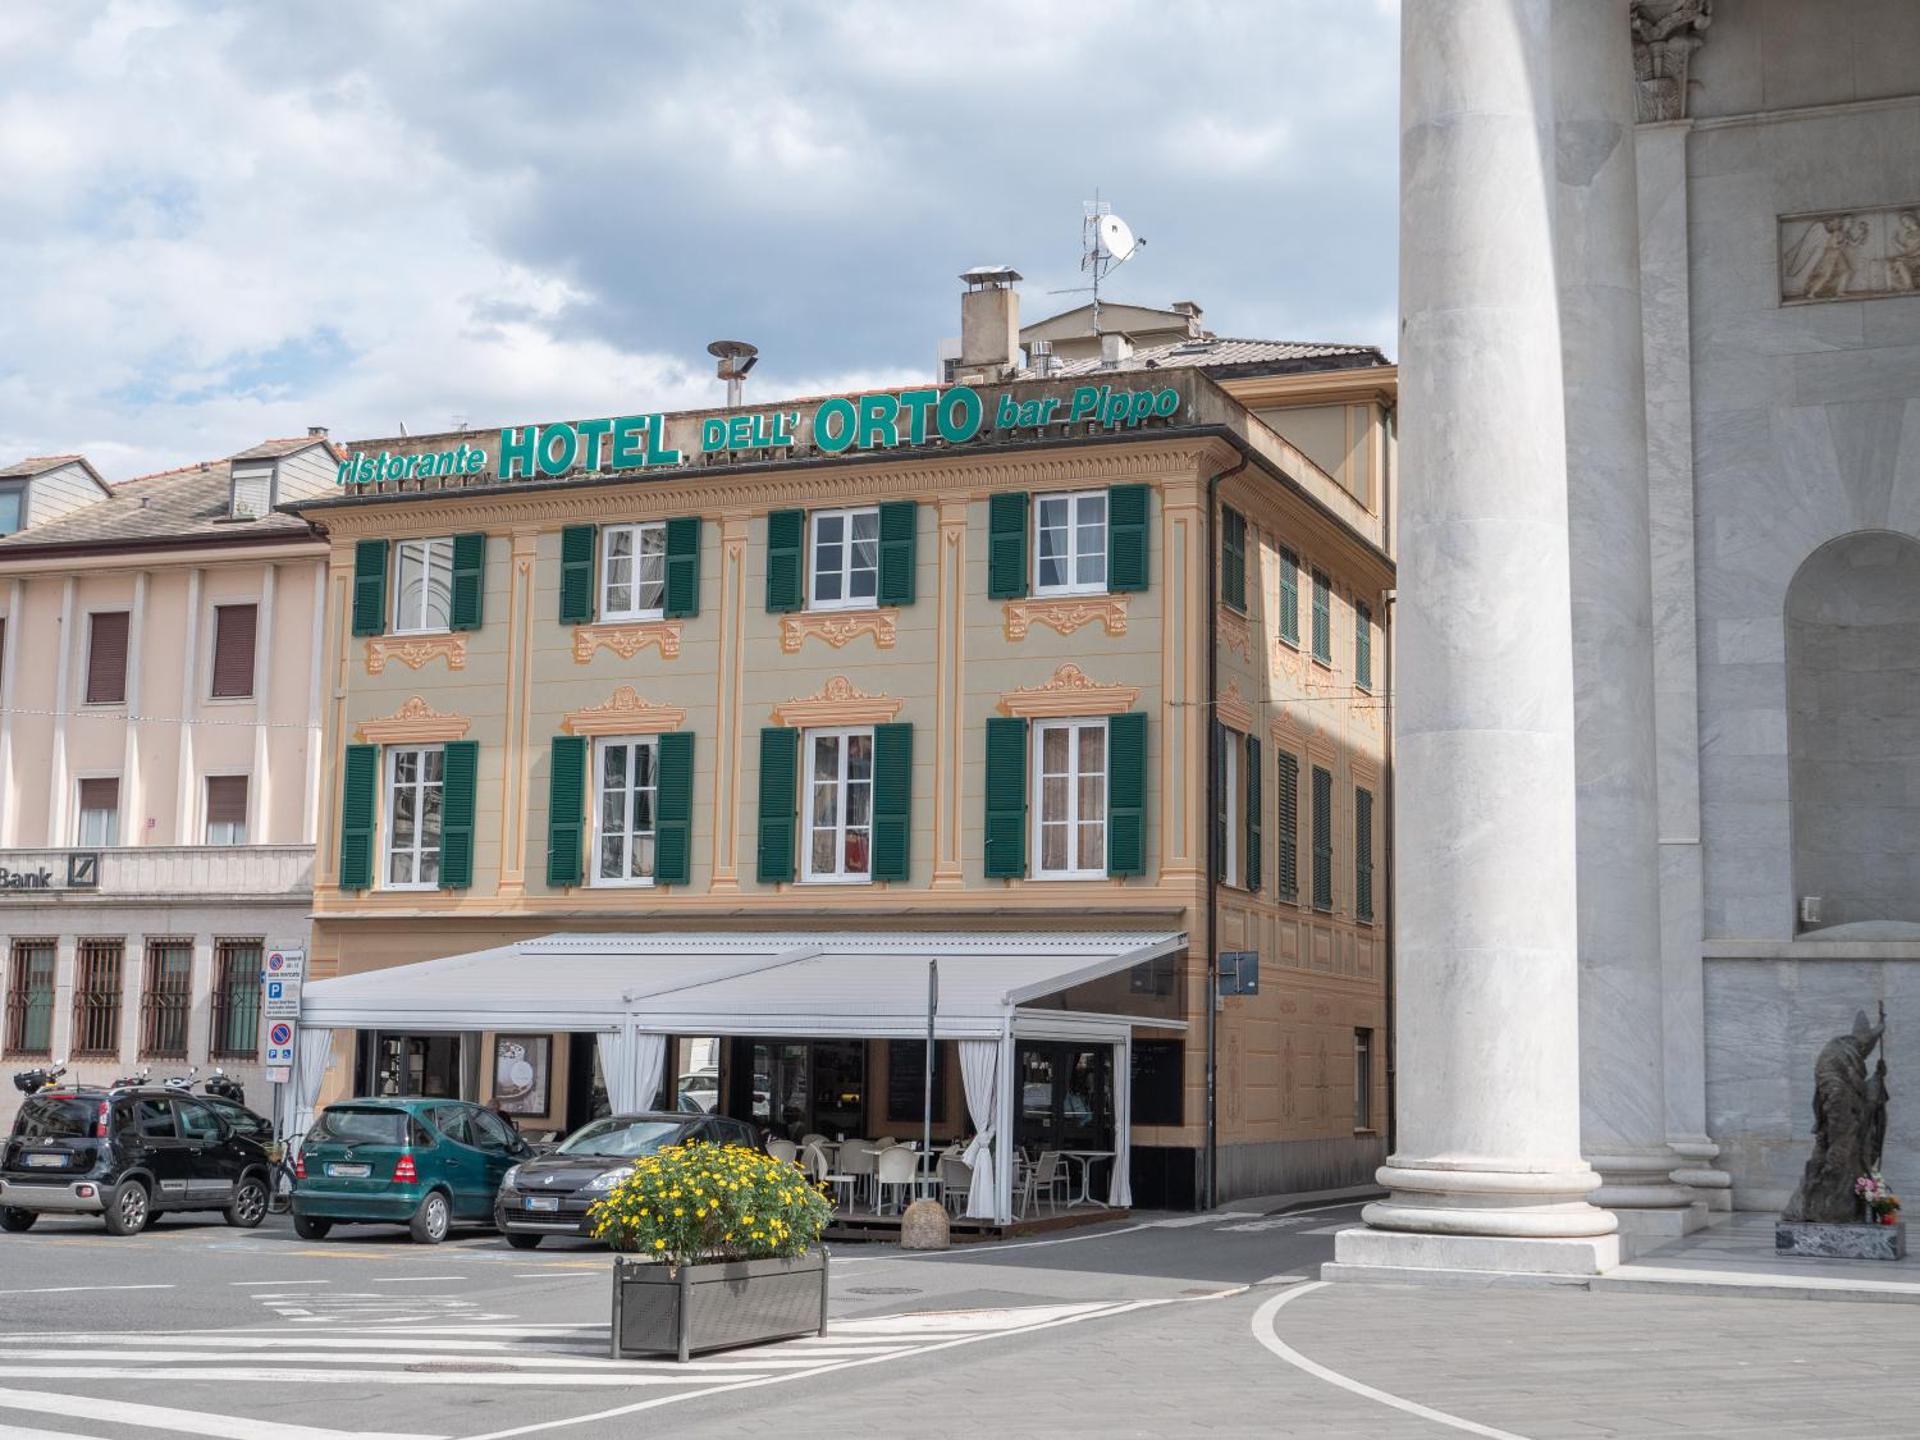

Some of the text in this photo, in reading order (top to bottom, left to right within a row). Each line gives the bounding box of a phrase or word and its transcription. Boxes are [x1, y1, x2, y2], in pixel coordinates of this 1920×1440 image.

[336, 385, 1180, 487] ristorante HOTEL DELL' ORTO bar Pippo
[0, 866, 53, 888] Bank
